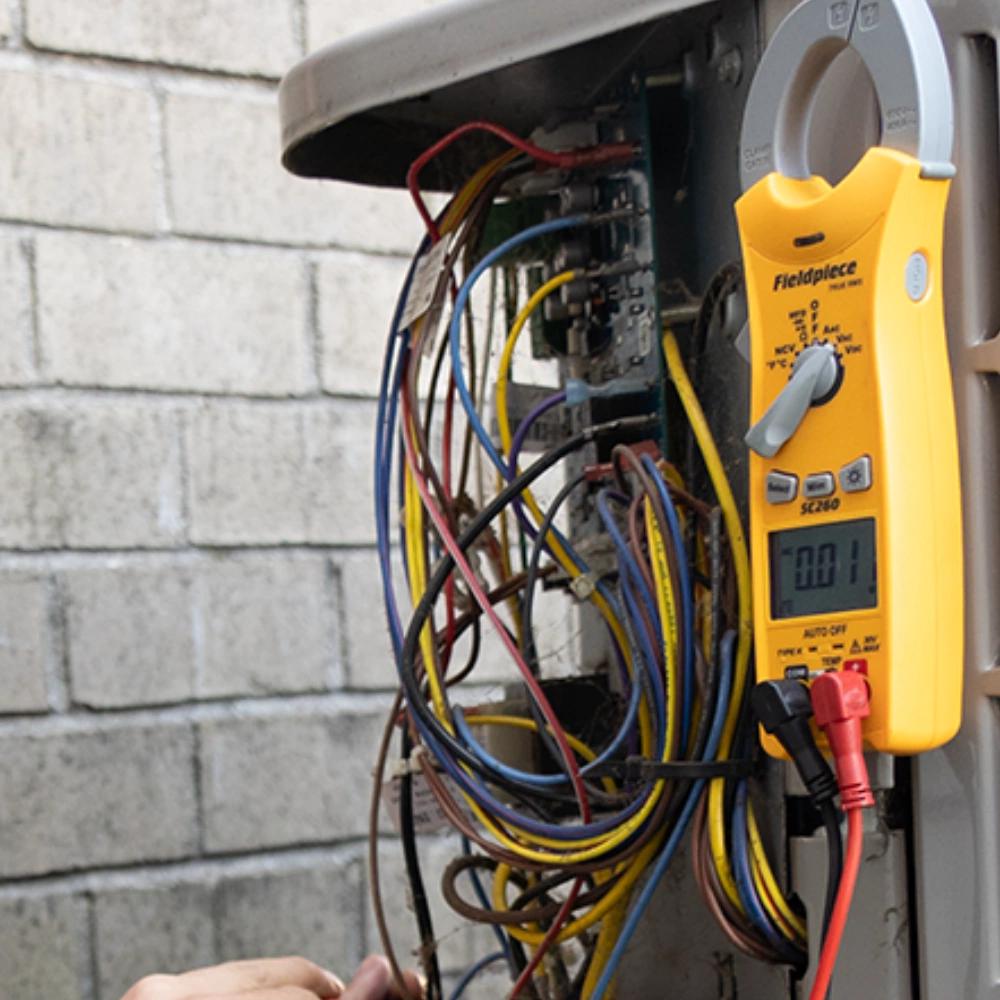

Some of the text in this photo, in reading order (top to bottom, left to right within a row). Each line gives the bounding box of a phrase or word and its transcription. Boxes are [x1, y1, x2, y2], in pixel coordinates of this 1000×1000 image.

[772, 260, 858, 292] Fieldpiece
[810, 299, 819, 334] OFF
[774, 344, 796, 355] NCV
[800, 497, 841, 515] SC260
[803, 624, 847, 639] AUTO OFF
[777, 647, 796, 657] TYPE
[821, 656, 842, 667] TEMP
